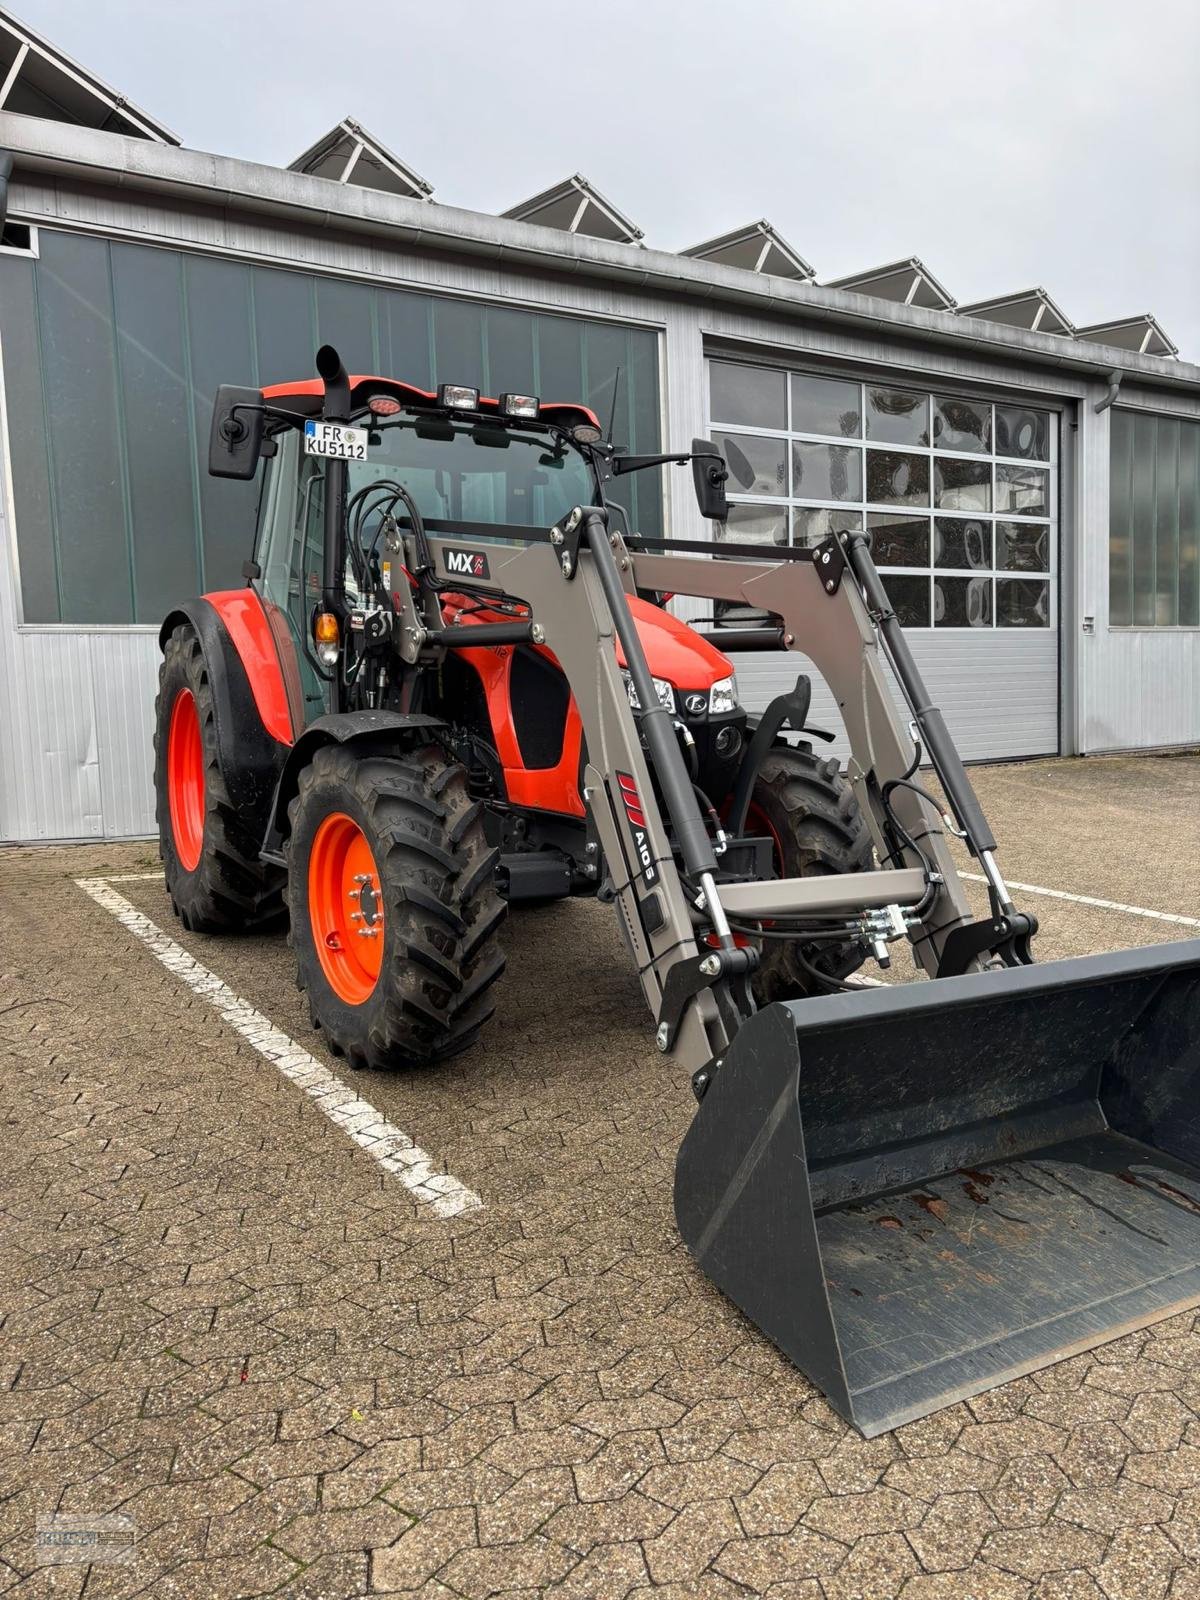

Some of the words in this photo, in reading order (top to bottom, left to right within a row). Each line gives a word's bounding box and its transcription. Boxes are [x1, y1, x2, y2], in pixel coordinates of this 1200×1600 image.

[323, 426, 341, 441] FR
[307, 438, 364, 459] KU5112
[448, 551, 474, 573] MX
